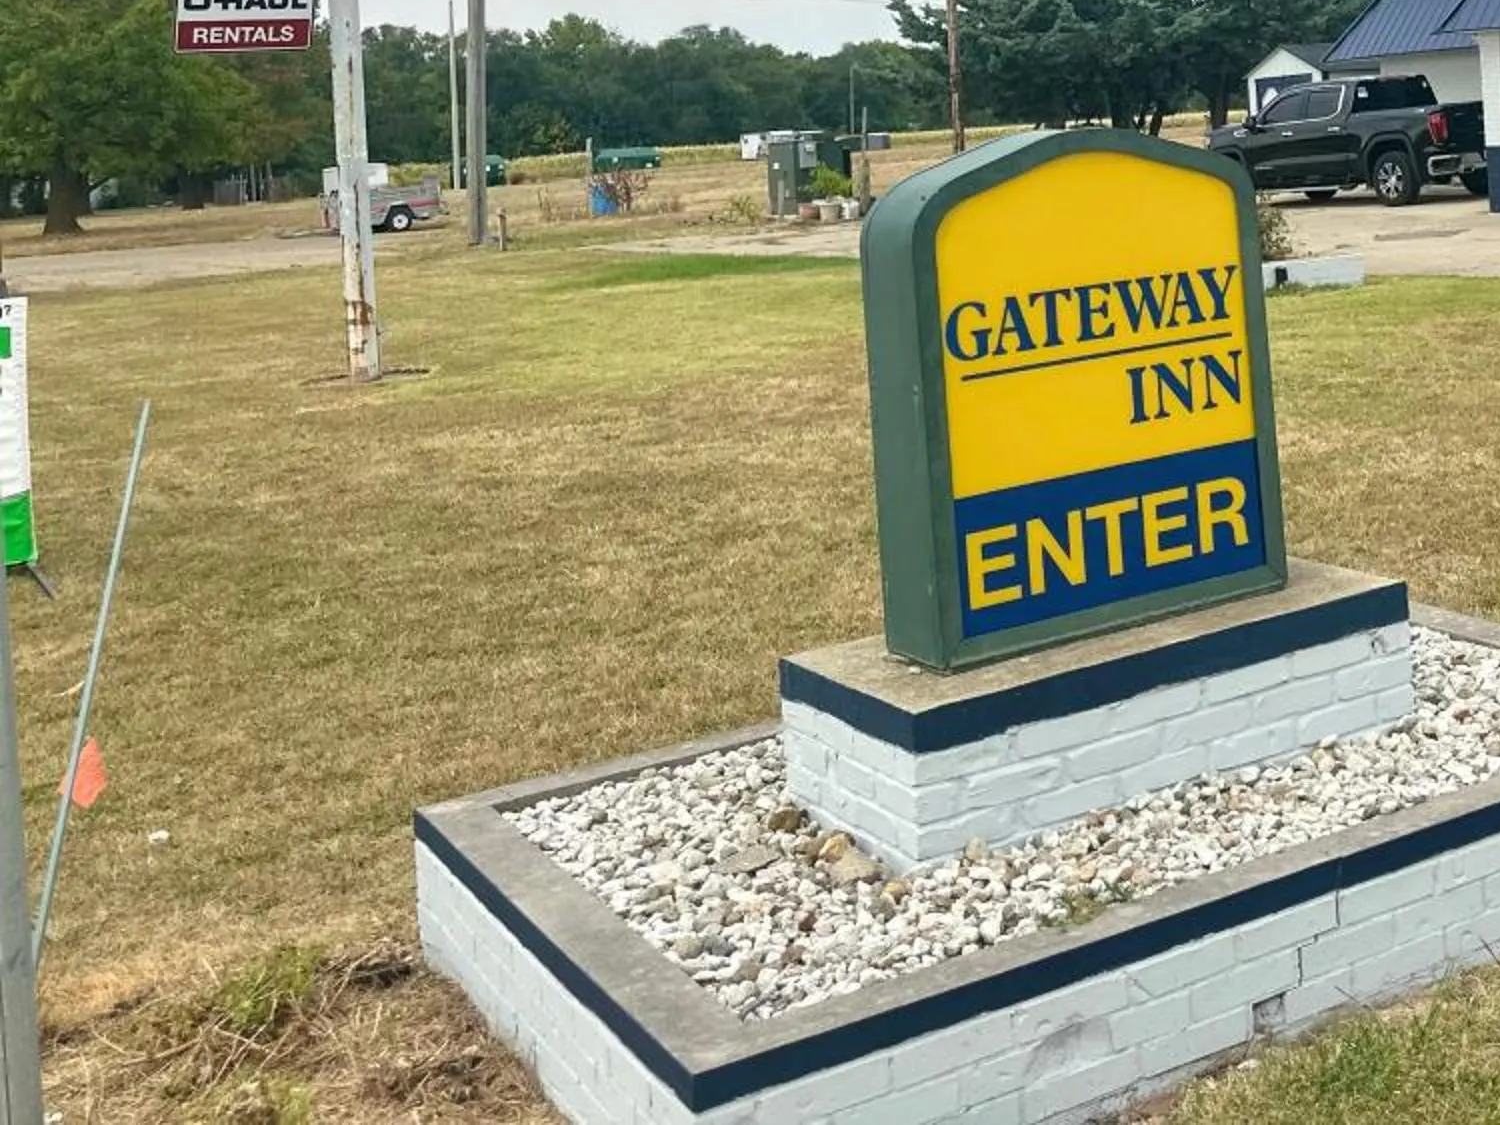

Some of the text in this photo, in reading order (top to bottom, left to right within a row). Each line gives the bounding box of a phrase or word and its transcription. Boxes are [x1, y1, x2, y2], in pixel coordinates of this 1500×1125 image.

[192, 25, 294, 45] RENTALS
[945, 265, 1238, 362] GATEWAY
[1126, 350, 1243, 424] INN
[965, 476, 1249, 610] ENTER
